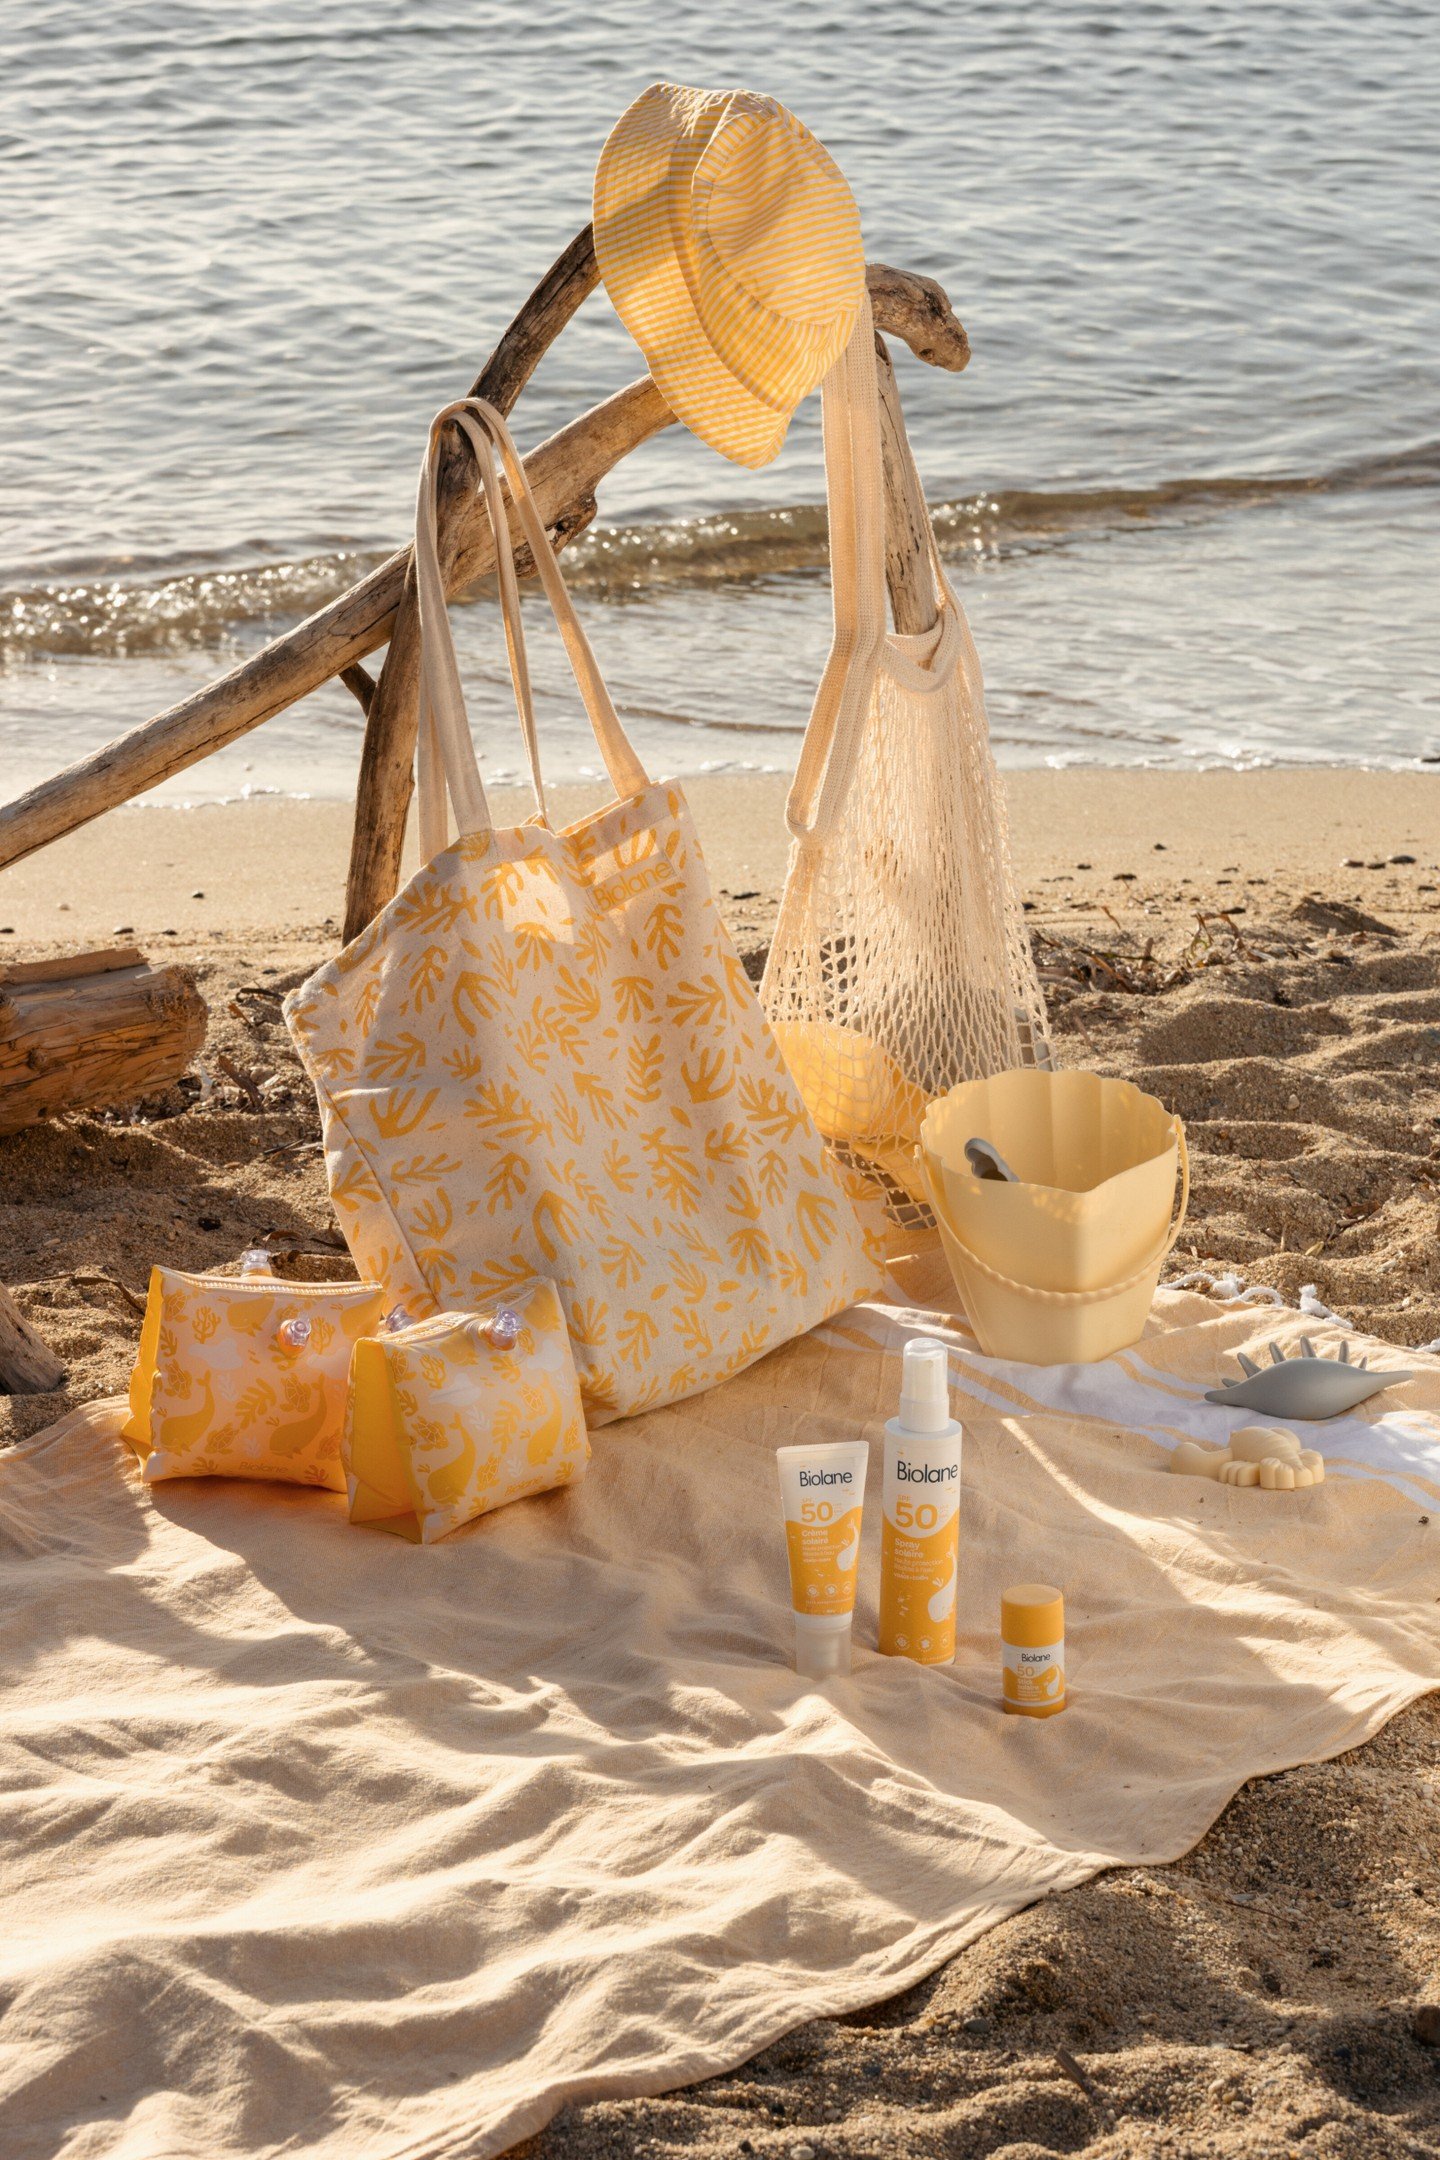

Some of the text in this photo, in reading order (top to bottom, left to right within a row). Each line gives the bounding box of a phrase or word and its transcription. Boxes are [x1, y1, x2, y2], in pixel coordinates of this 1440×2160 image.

[593, 862, 671, 912] Biolane
[799, 1470, 853, 1487] Biolane
[897, 1460, 958, 1483] Biolane
[801, 1501, 833, 1523] 50
[895, 1502, 938, 1530] 50
[894, 1538, 920, 1550] Spray
[1021, 1653, 1051, 1663] Biolane
[1017, 1664, 1034, 1677] 50
